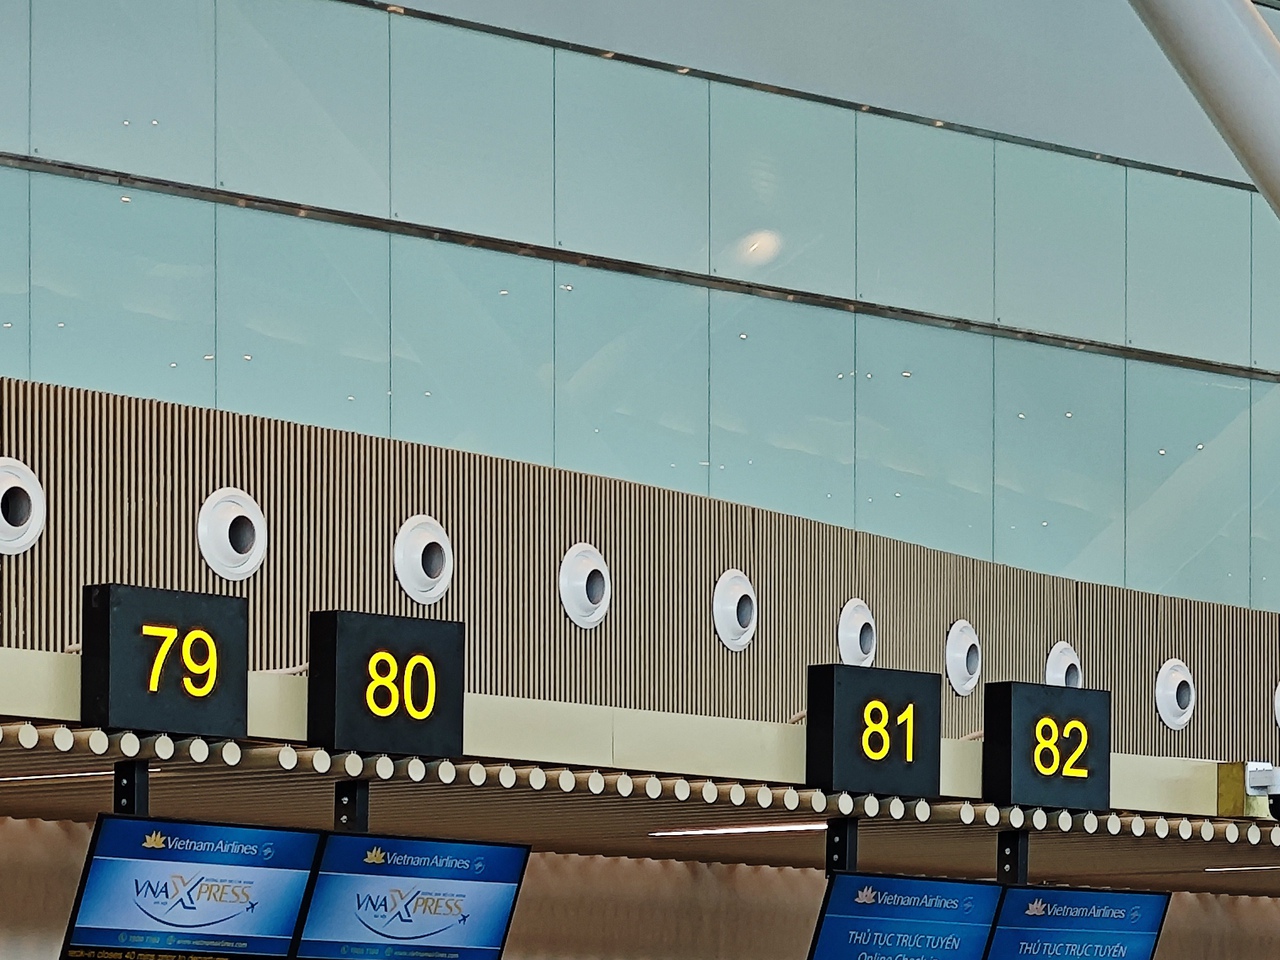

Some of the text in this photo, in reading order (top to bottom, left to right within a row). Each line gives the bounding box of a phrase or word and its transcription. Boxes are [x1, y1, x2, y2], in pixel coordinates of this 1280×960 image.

[142, 625, 218, 697] 79
[366, 651, 436, 720] 80
[862, 700, 915, 762] 81
[1034, 717, 1089, 778] 82
[125, 951, 136, 960] 40
[873, 932, 895, 949] TỤC
